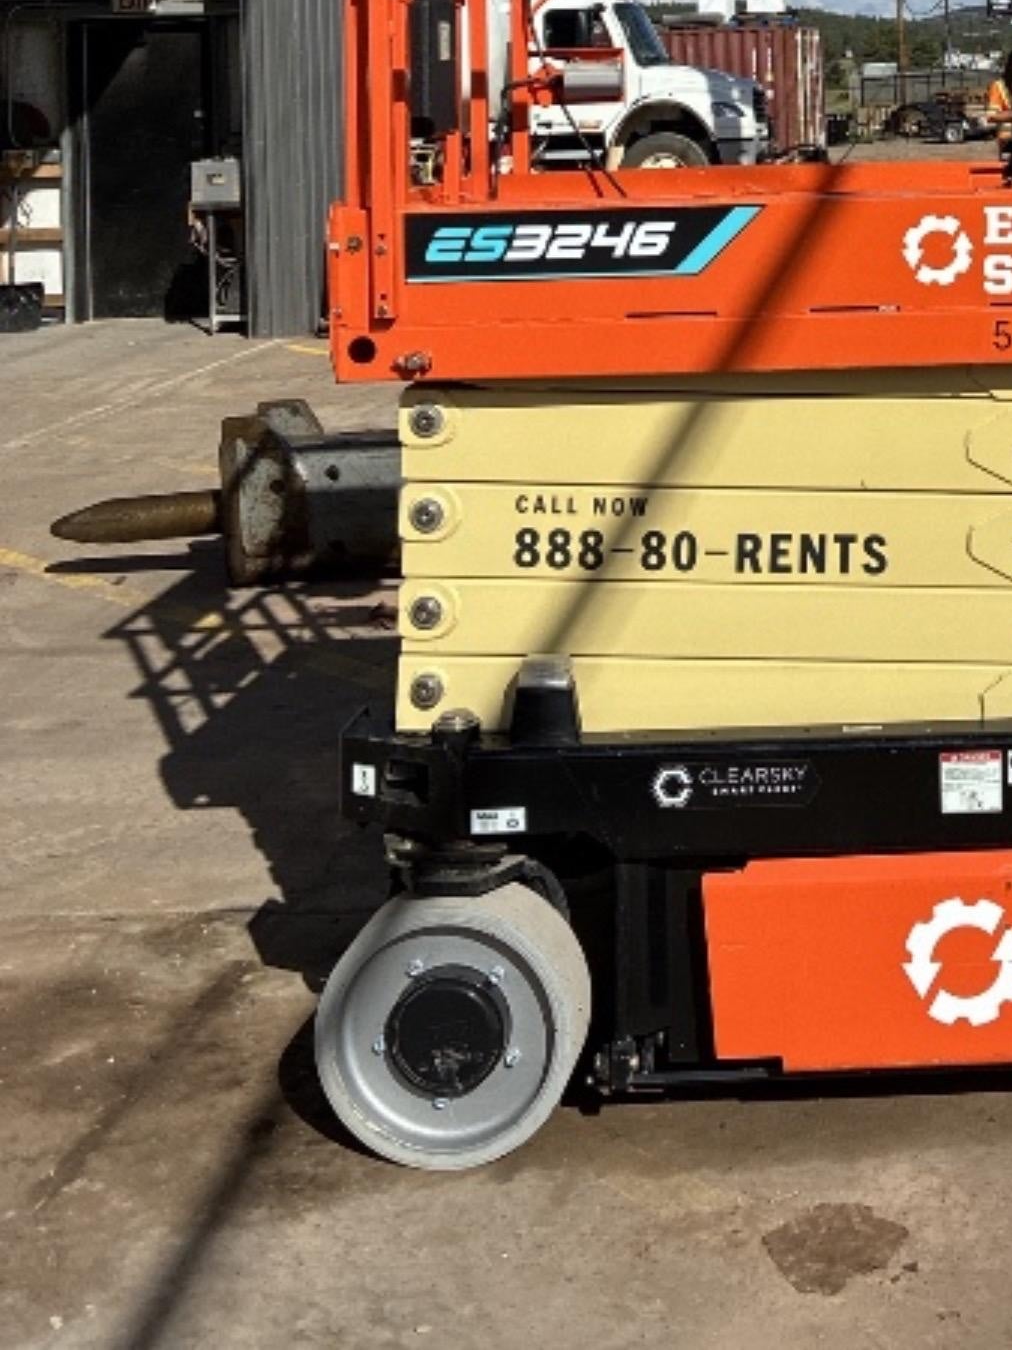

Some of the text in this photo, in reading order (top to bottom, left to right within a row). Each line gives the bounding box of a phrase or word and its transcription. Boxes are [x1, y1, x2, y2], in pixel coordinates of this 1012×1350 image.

[425, 221, 677, 263] ES3246
[514, 495, 649, 517] CALL NOW
[512, 526, 889, 576] 888-80-RENTS
[699, 765, 808, 785] CLEARSKY
